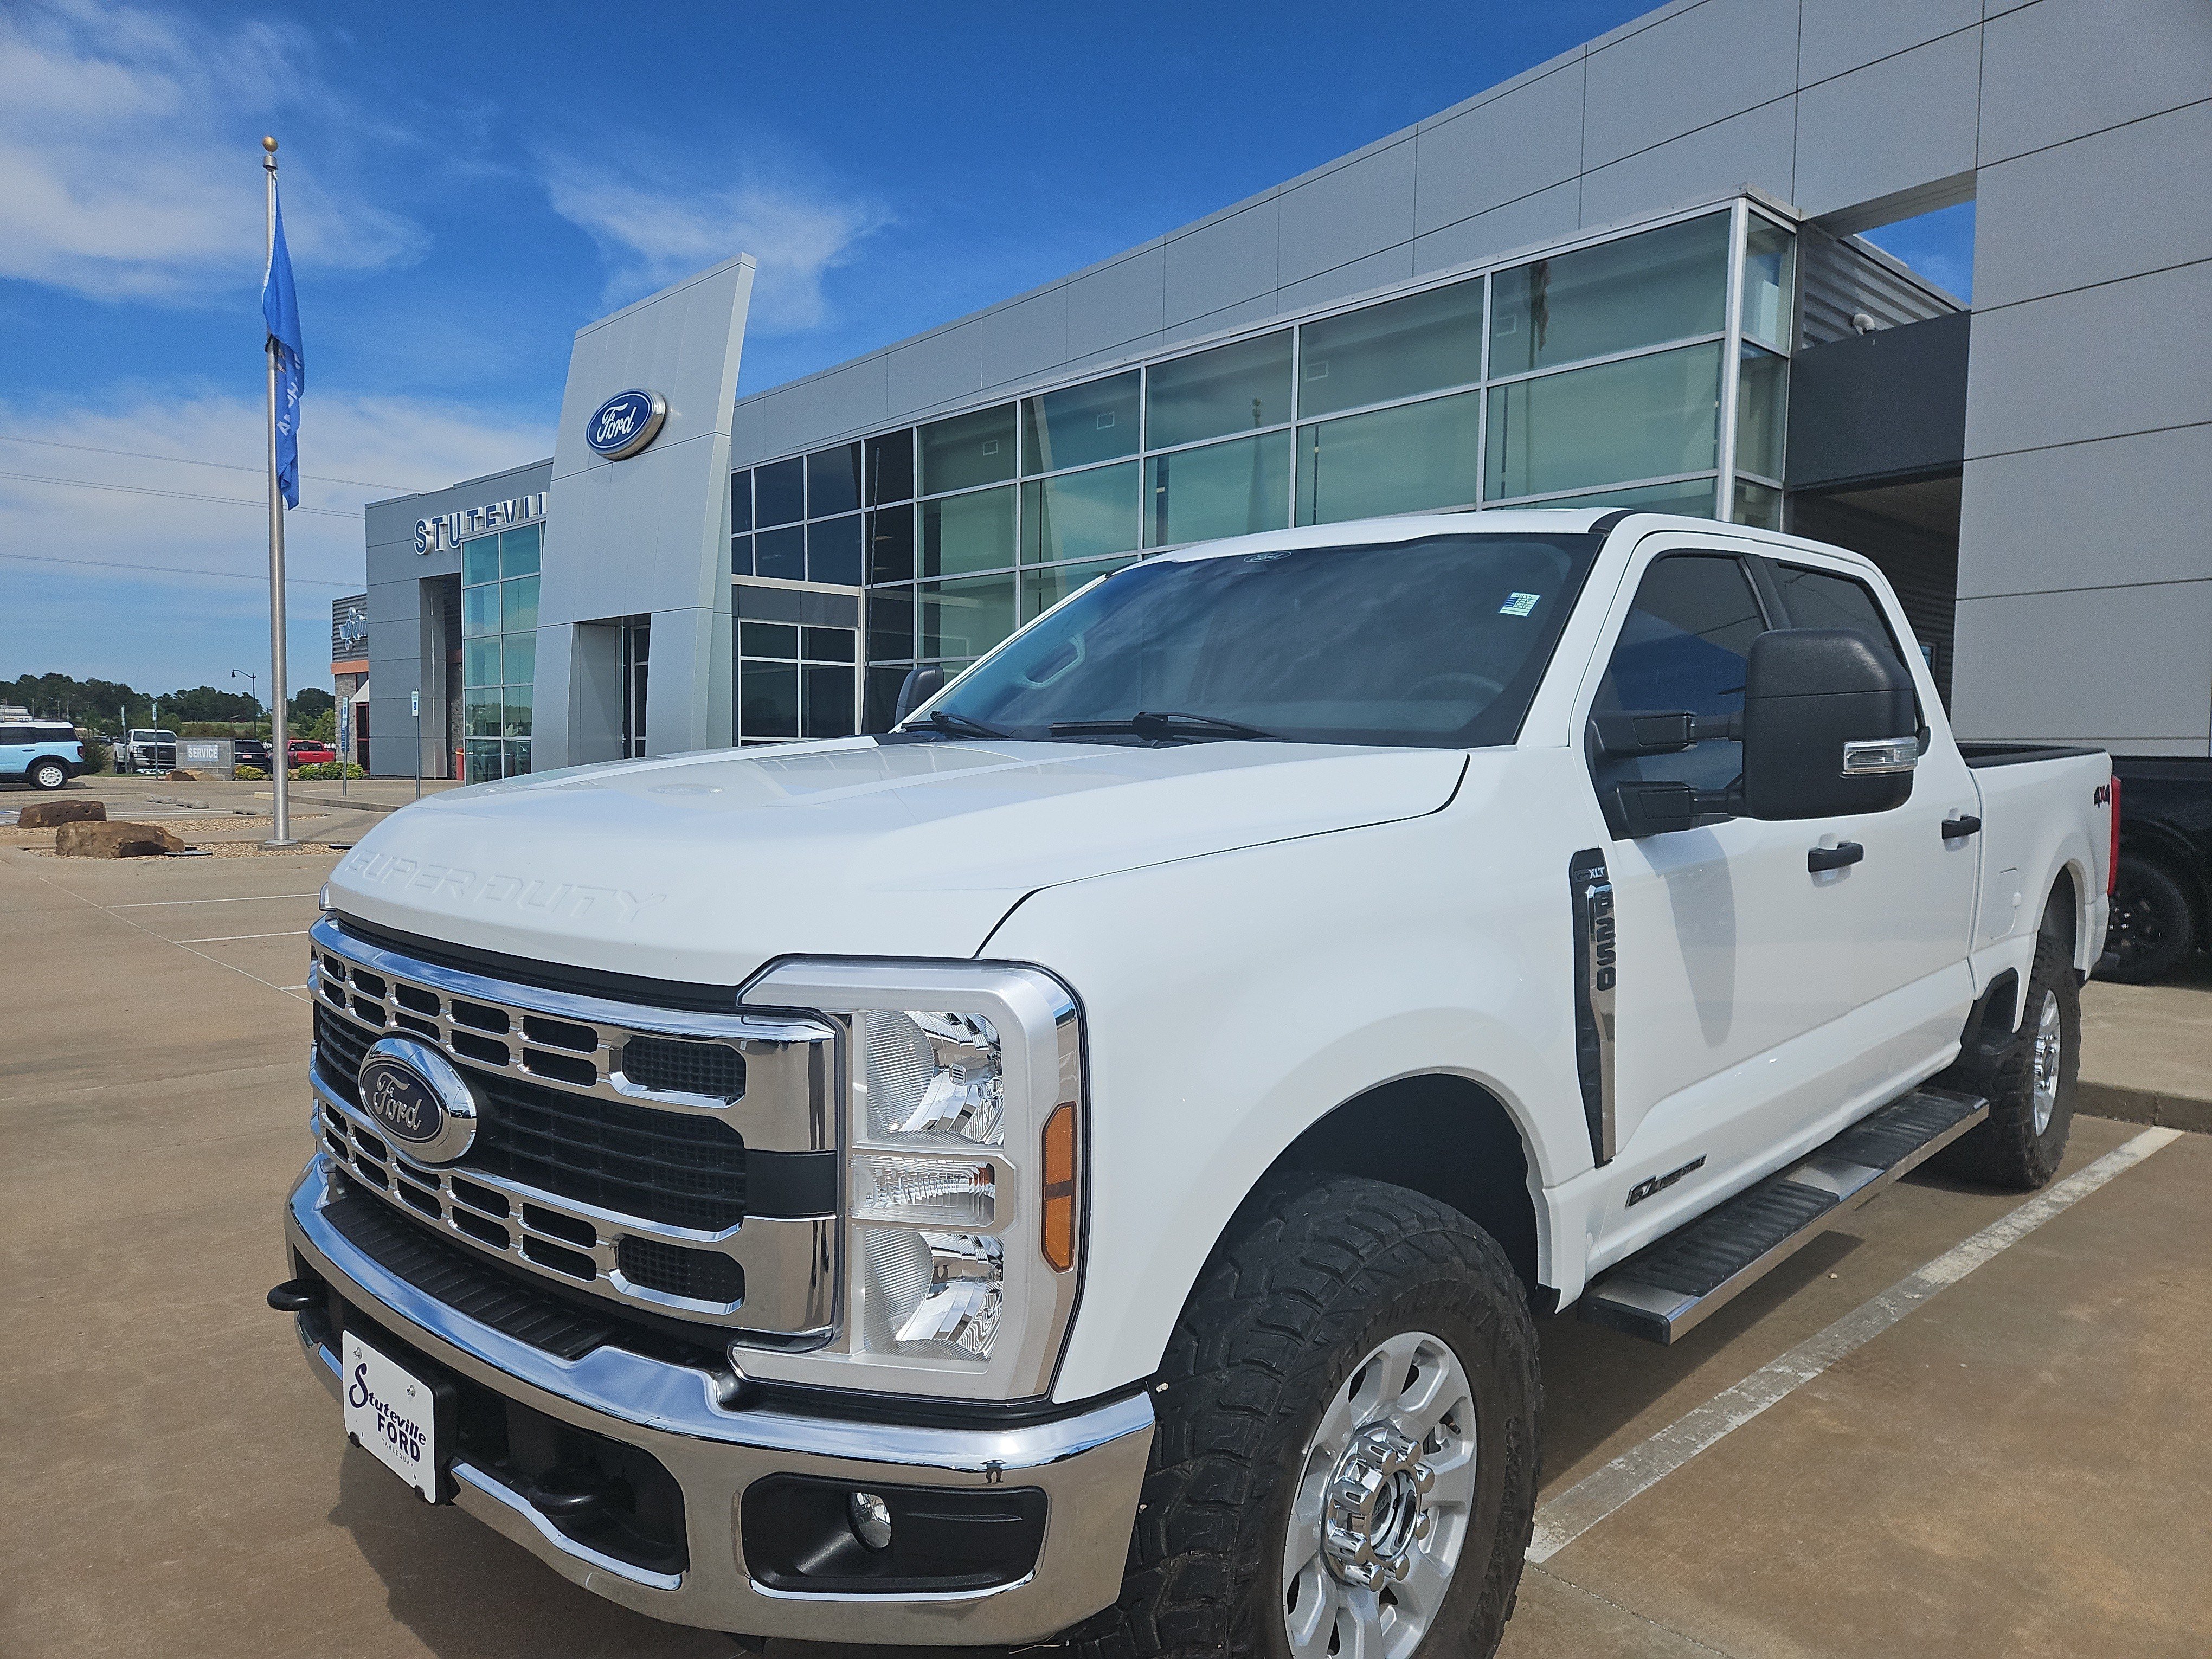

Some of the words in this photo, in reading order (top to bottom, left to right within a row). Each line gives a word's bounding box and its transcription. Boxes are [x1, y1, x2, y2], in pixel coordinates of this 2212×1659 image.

[596, 402, 637, 443] Ford
[188, 748, 218, 759] SERVICE
[345, 849, 477, 900] SUPER
[474, 874, 668, 923] DUTY
[1588, 866, 1605, 879] XLT
[373, 1072, 423, 1130] Ford
[349, 1362, 426, 1446] Stuteville
[377, 1411, 421, 1462] FORD
[382, 1438, 414, 1469] TAHLEQUAH
